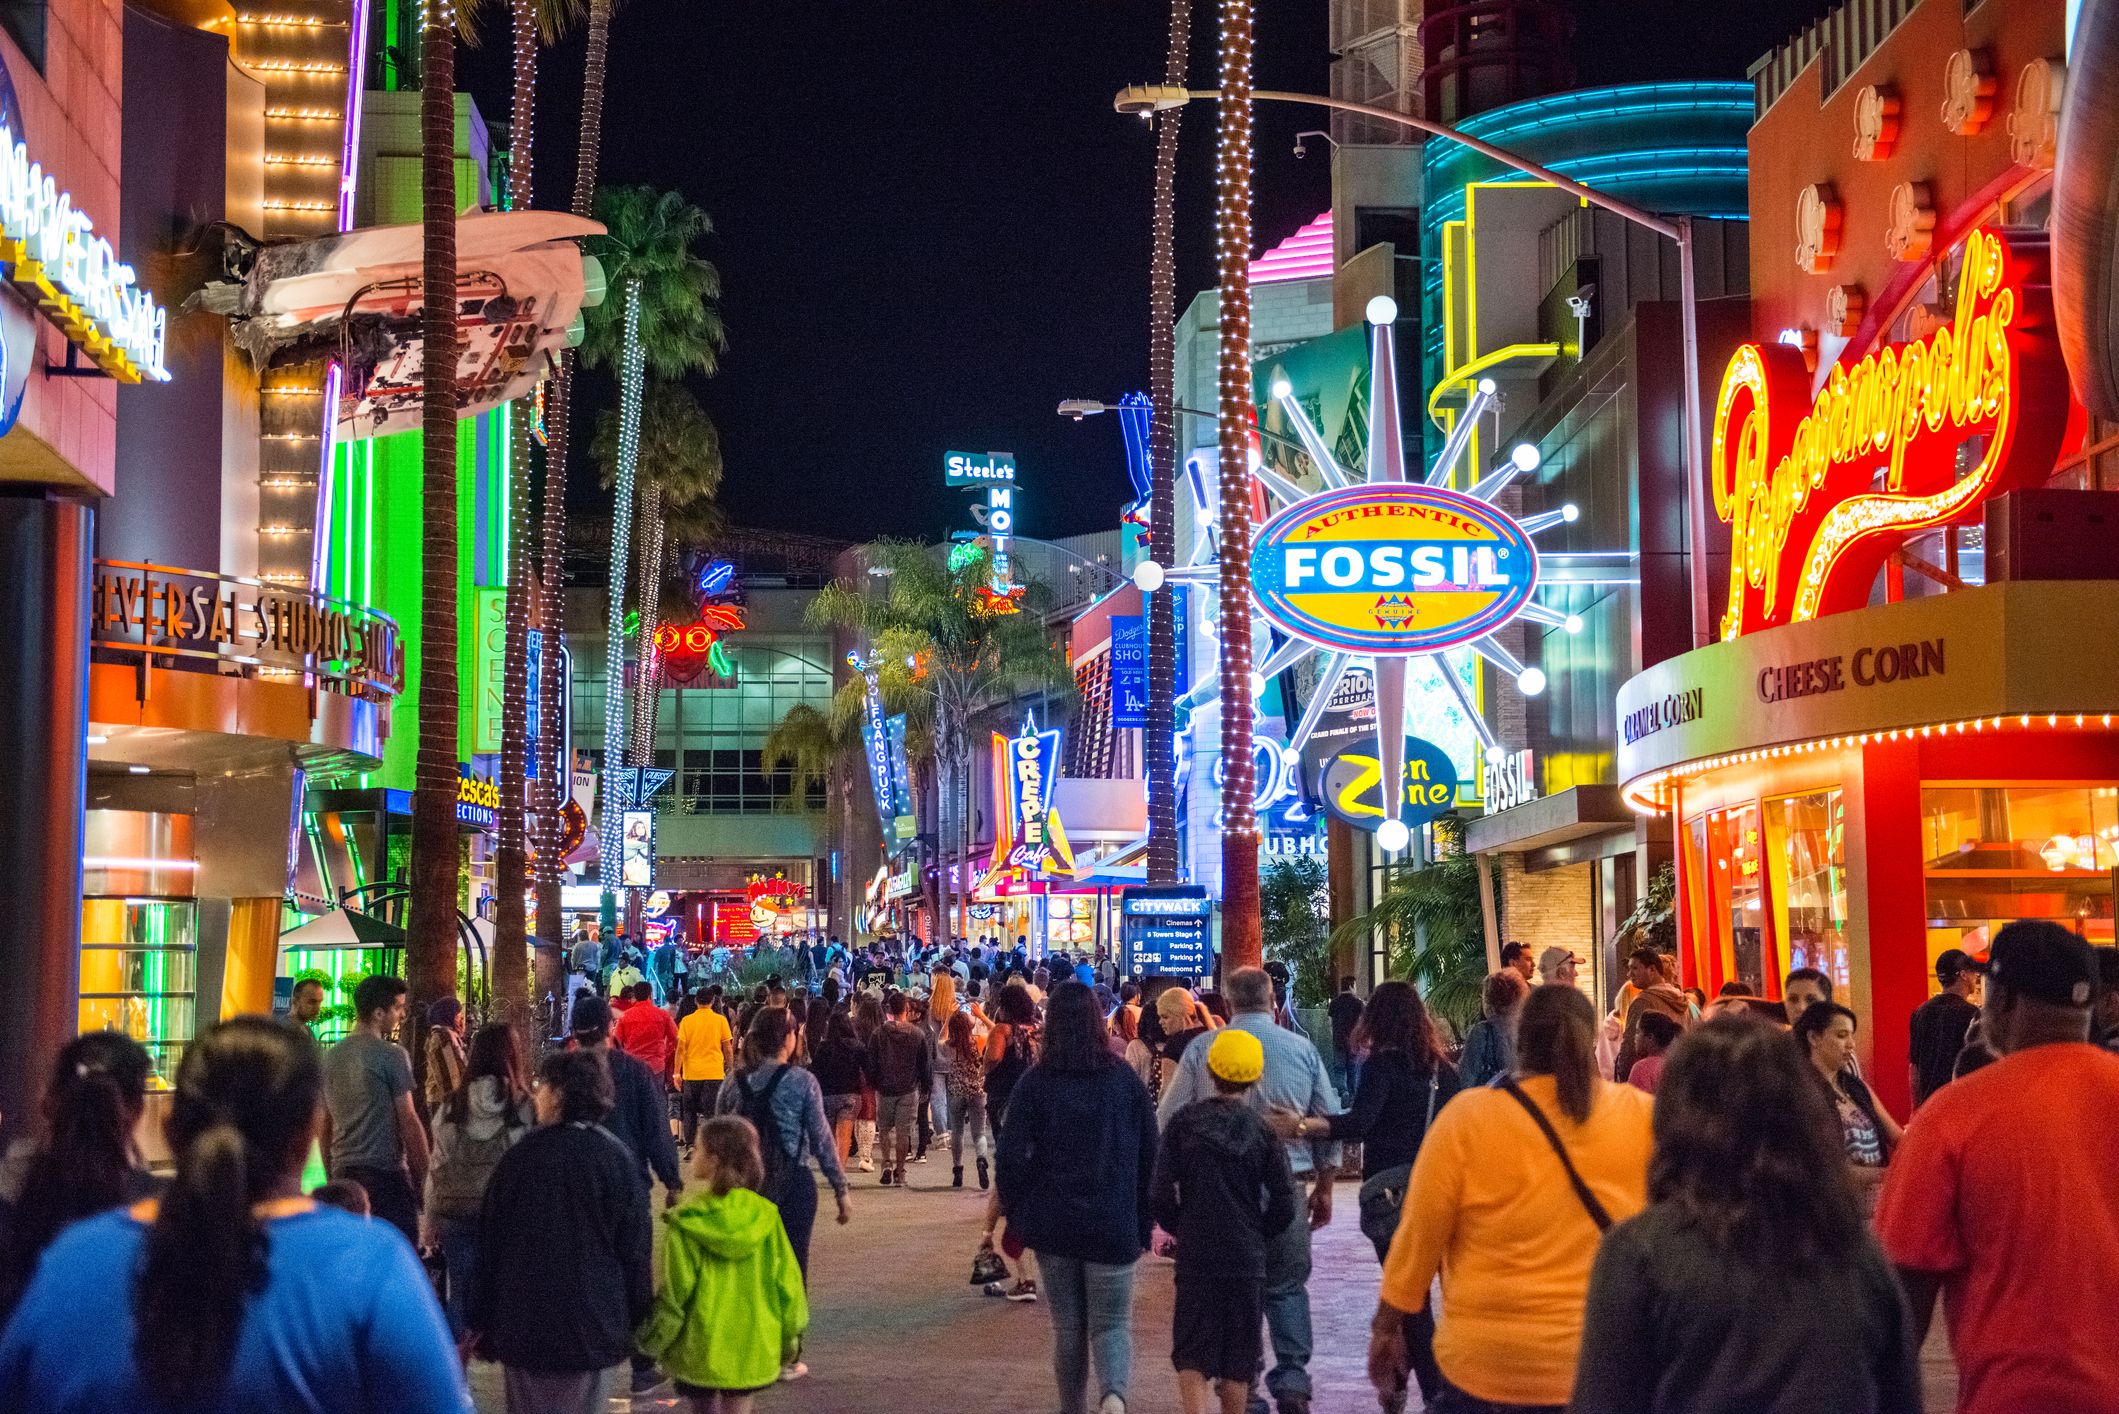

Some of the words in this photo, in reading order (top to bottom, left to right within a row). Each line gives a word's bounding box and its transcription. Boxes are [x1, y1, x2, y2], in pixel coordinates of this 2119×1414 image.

[948, 456, 1014, 479] Steele's
[1305, 505, 1481, 539] AUTHENTIC
[255, 595, 353, 663] STUDIOS
[1756, 655, 1845, 704] CHEESE
[1851, 638, 1944, 687] CORN
[1353, 710, 1369, 718] NOW
[1663, 687, 1703, 729] CORN
[1311, 730, 1329, 739] GRAND
[1329, 727, 1349, 737] FINALE
[1358, 724, 1369, 732] THE
[877, 765, 892, 811] PUCK
[1017, 736, 1042, 844] CREPE
[1483, 749, 1532, 816] FOSSIL
[1131, 902, 1201, 912] CITYWALK
